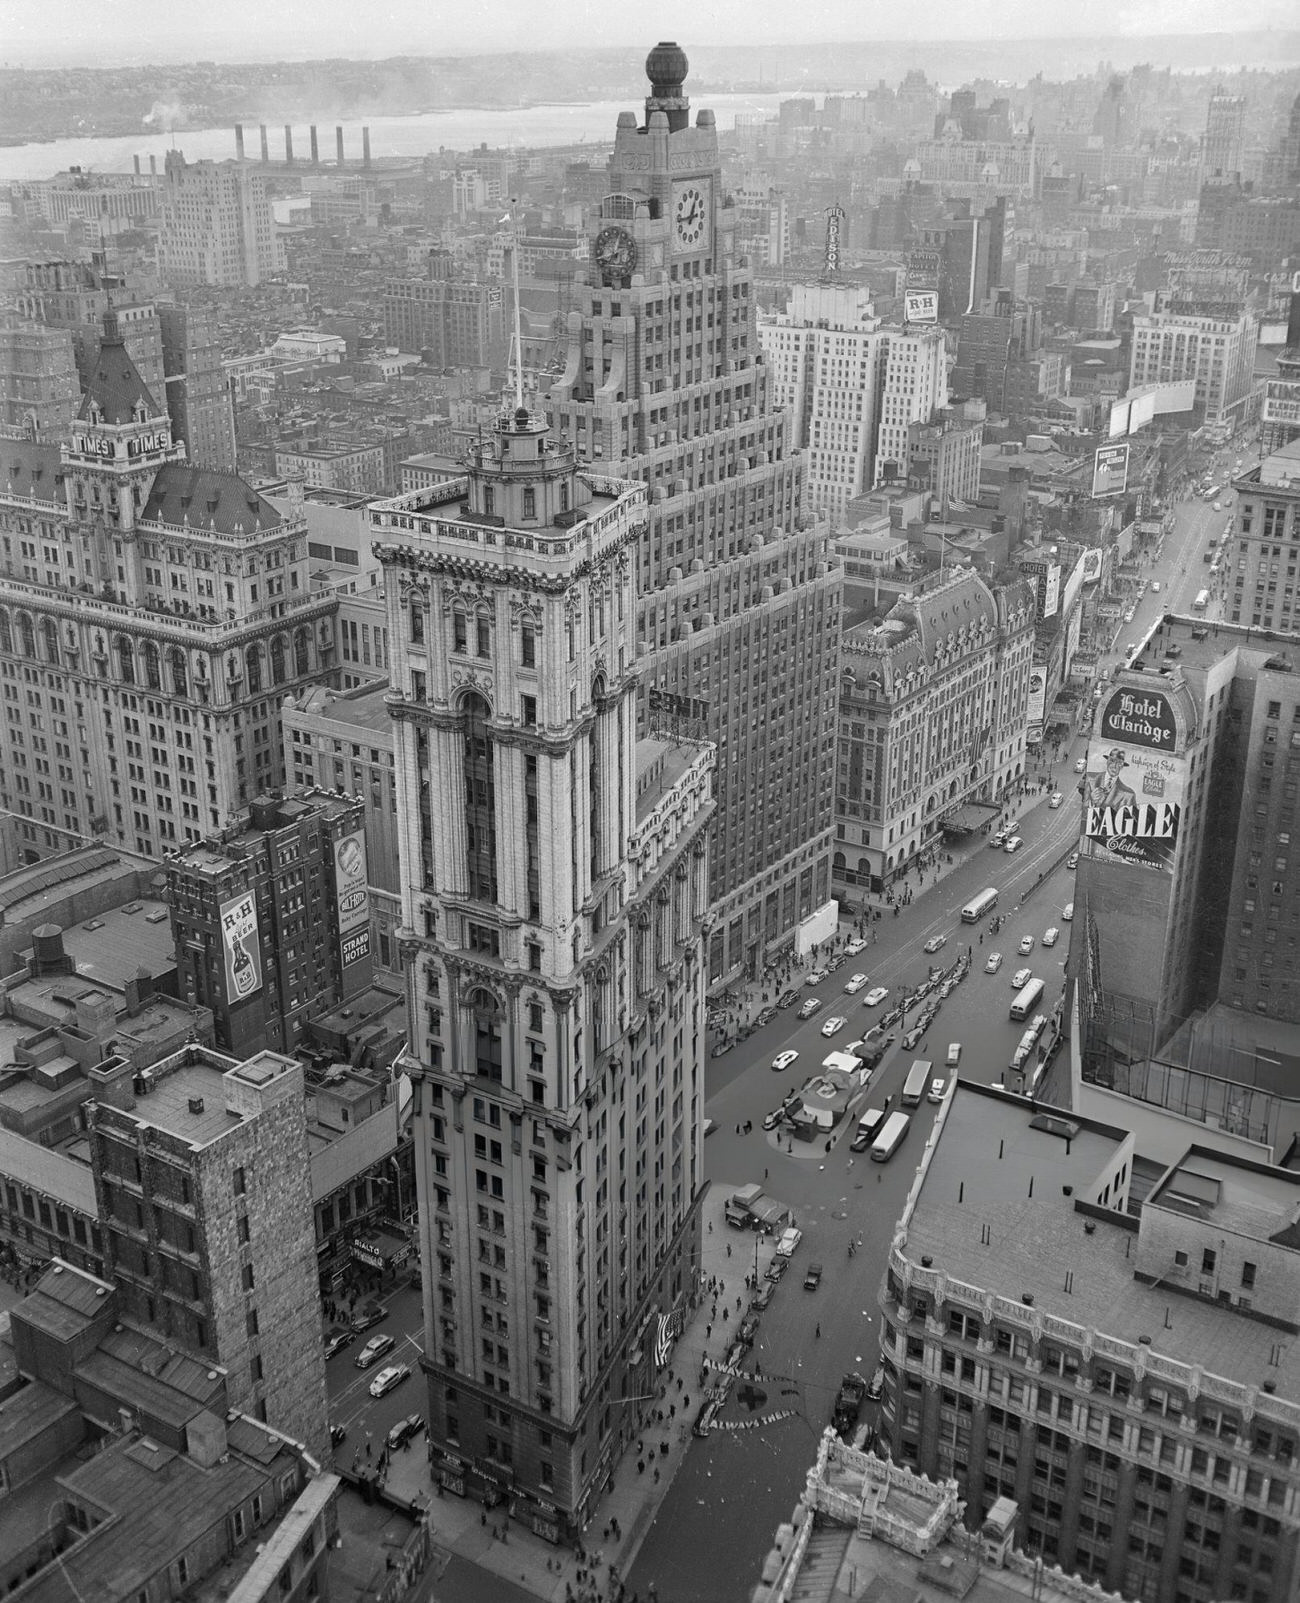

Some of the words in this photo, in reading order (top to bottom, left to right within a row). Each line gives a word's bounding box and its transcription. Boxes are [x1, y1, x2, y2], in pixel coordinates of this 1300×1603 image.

[828, 215, 838, 271] EDISON
[78, 436, 109, 455] TIMES
[132, 433, 166, 453] TIMES
[1024, 564, 1047, 574] HOTEL
[1035, 578, 1047, 625] ASTOR
[1119, 693, 1162, 719] Hotel
[1109, 713, 1171, 743] Claridge
[1086, 803, 1176, 838] EAGLE
[232, 923, 253, 943] BEER
[343, 933, 368, 954] STRAND
[345, 944, 368, 963] HOTEL
[354, 1239, 379, 1255] RIALTO
[703, 1358, 750, 1380] ALWAYS
[709, 1418, 759, 1430] ALWAYS
